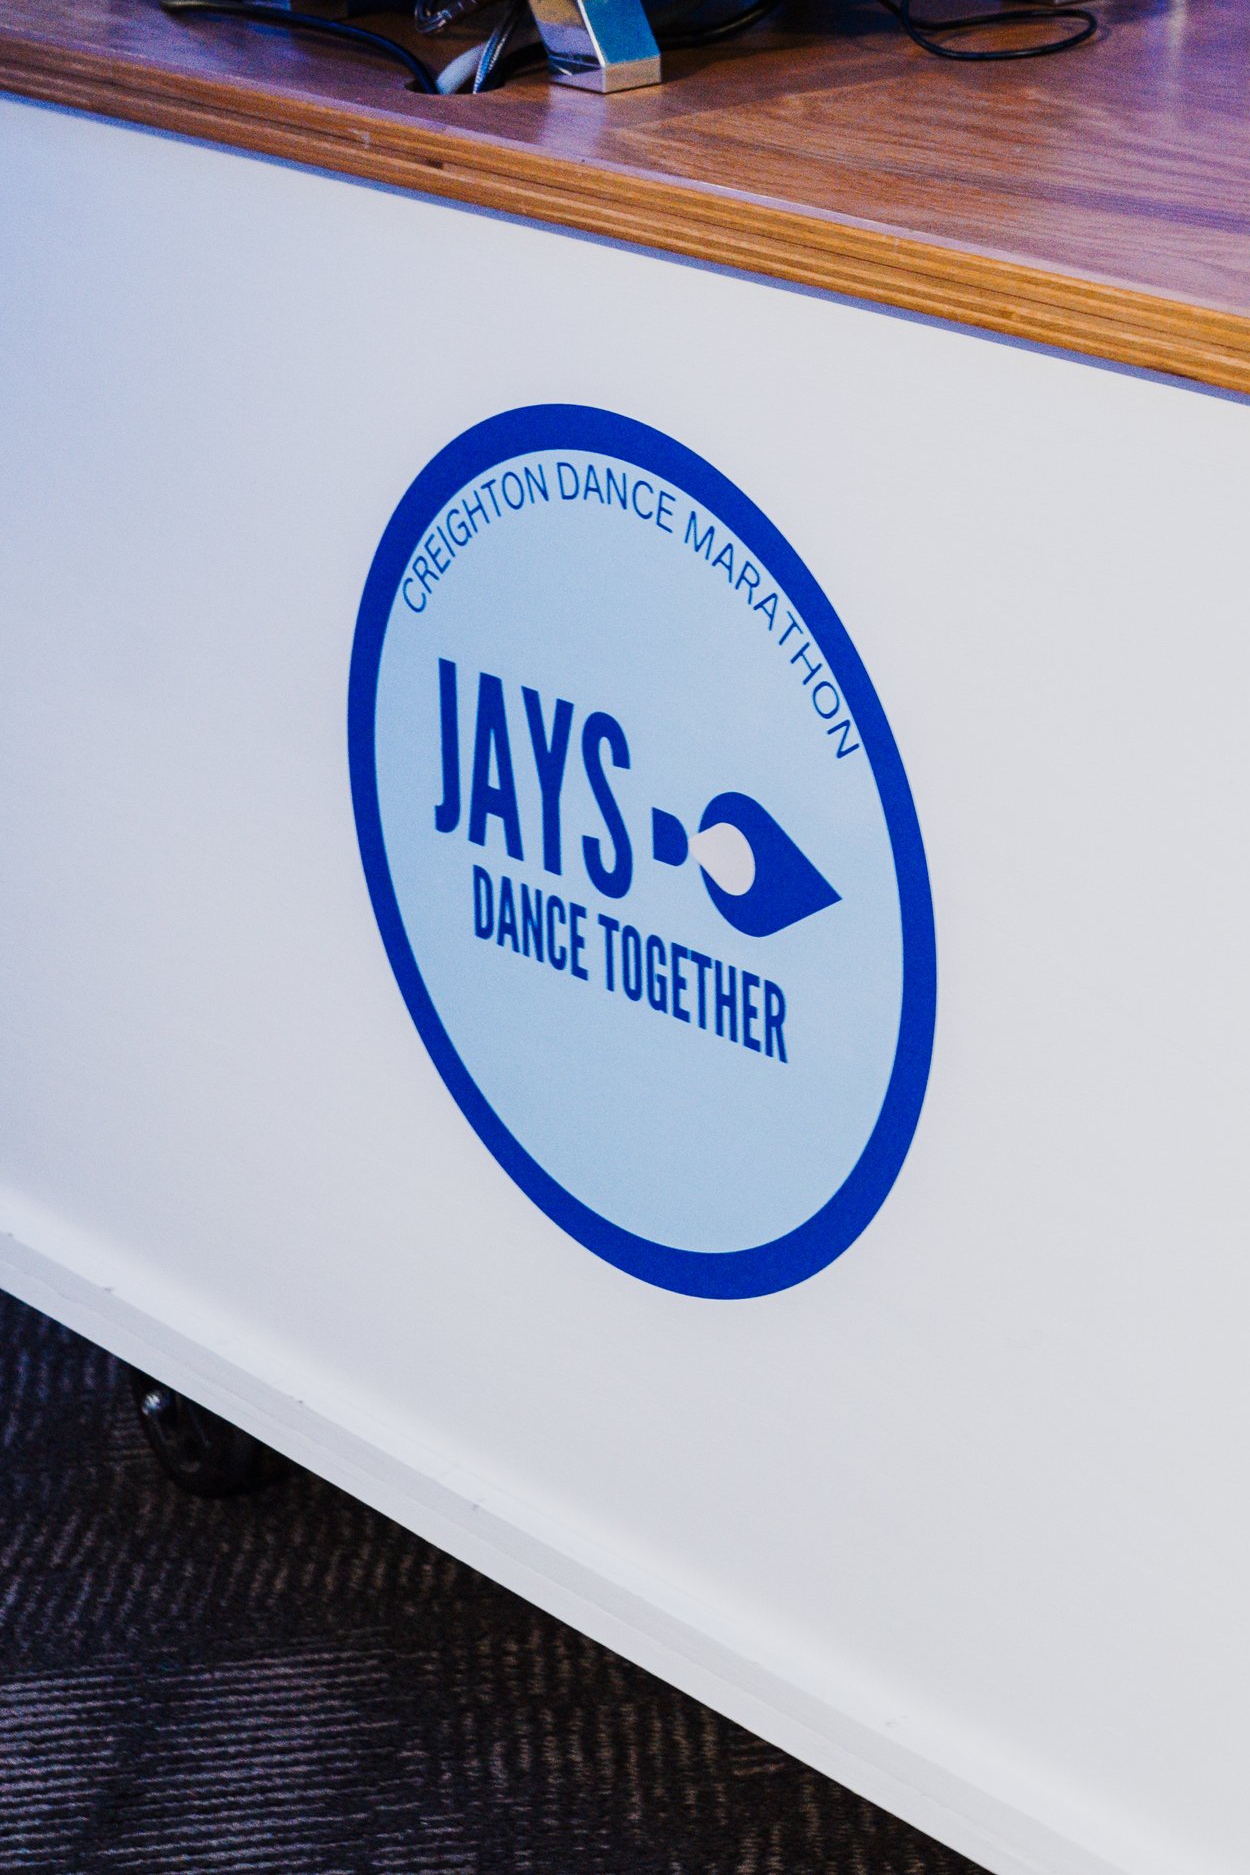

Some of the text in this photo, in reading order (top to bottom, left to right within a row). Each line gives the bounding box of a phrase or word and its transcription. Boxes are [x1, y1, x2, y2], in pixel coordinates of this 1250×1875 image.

[402, 461, 861, 760] CREIGHTON DANCE MARATHON
[434, 657, 634, 900] JAYS
[472, 864, 789, 1064] DANCE TOGETHER
